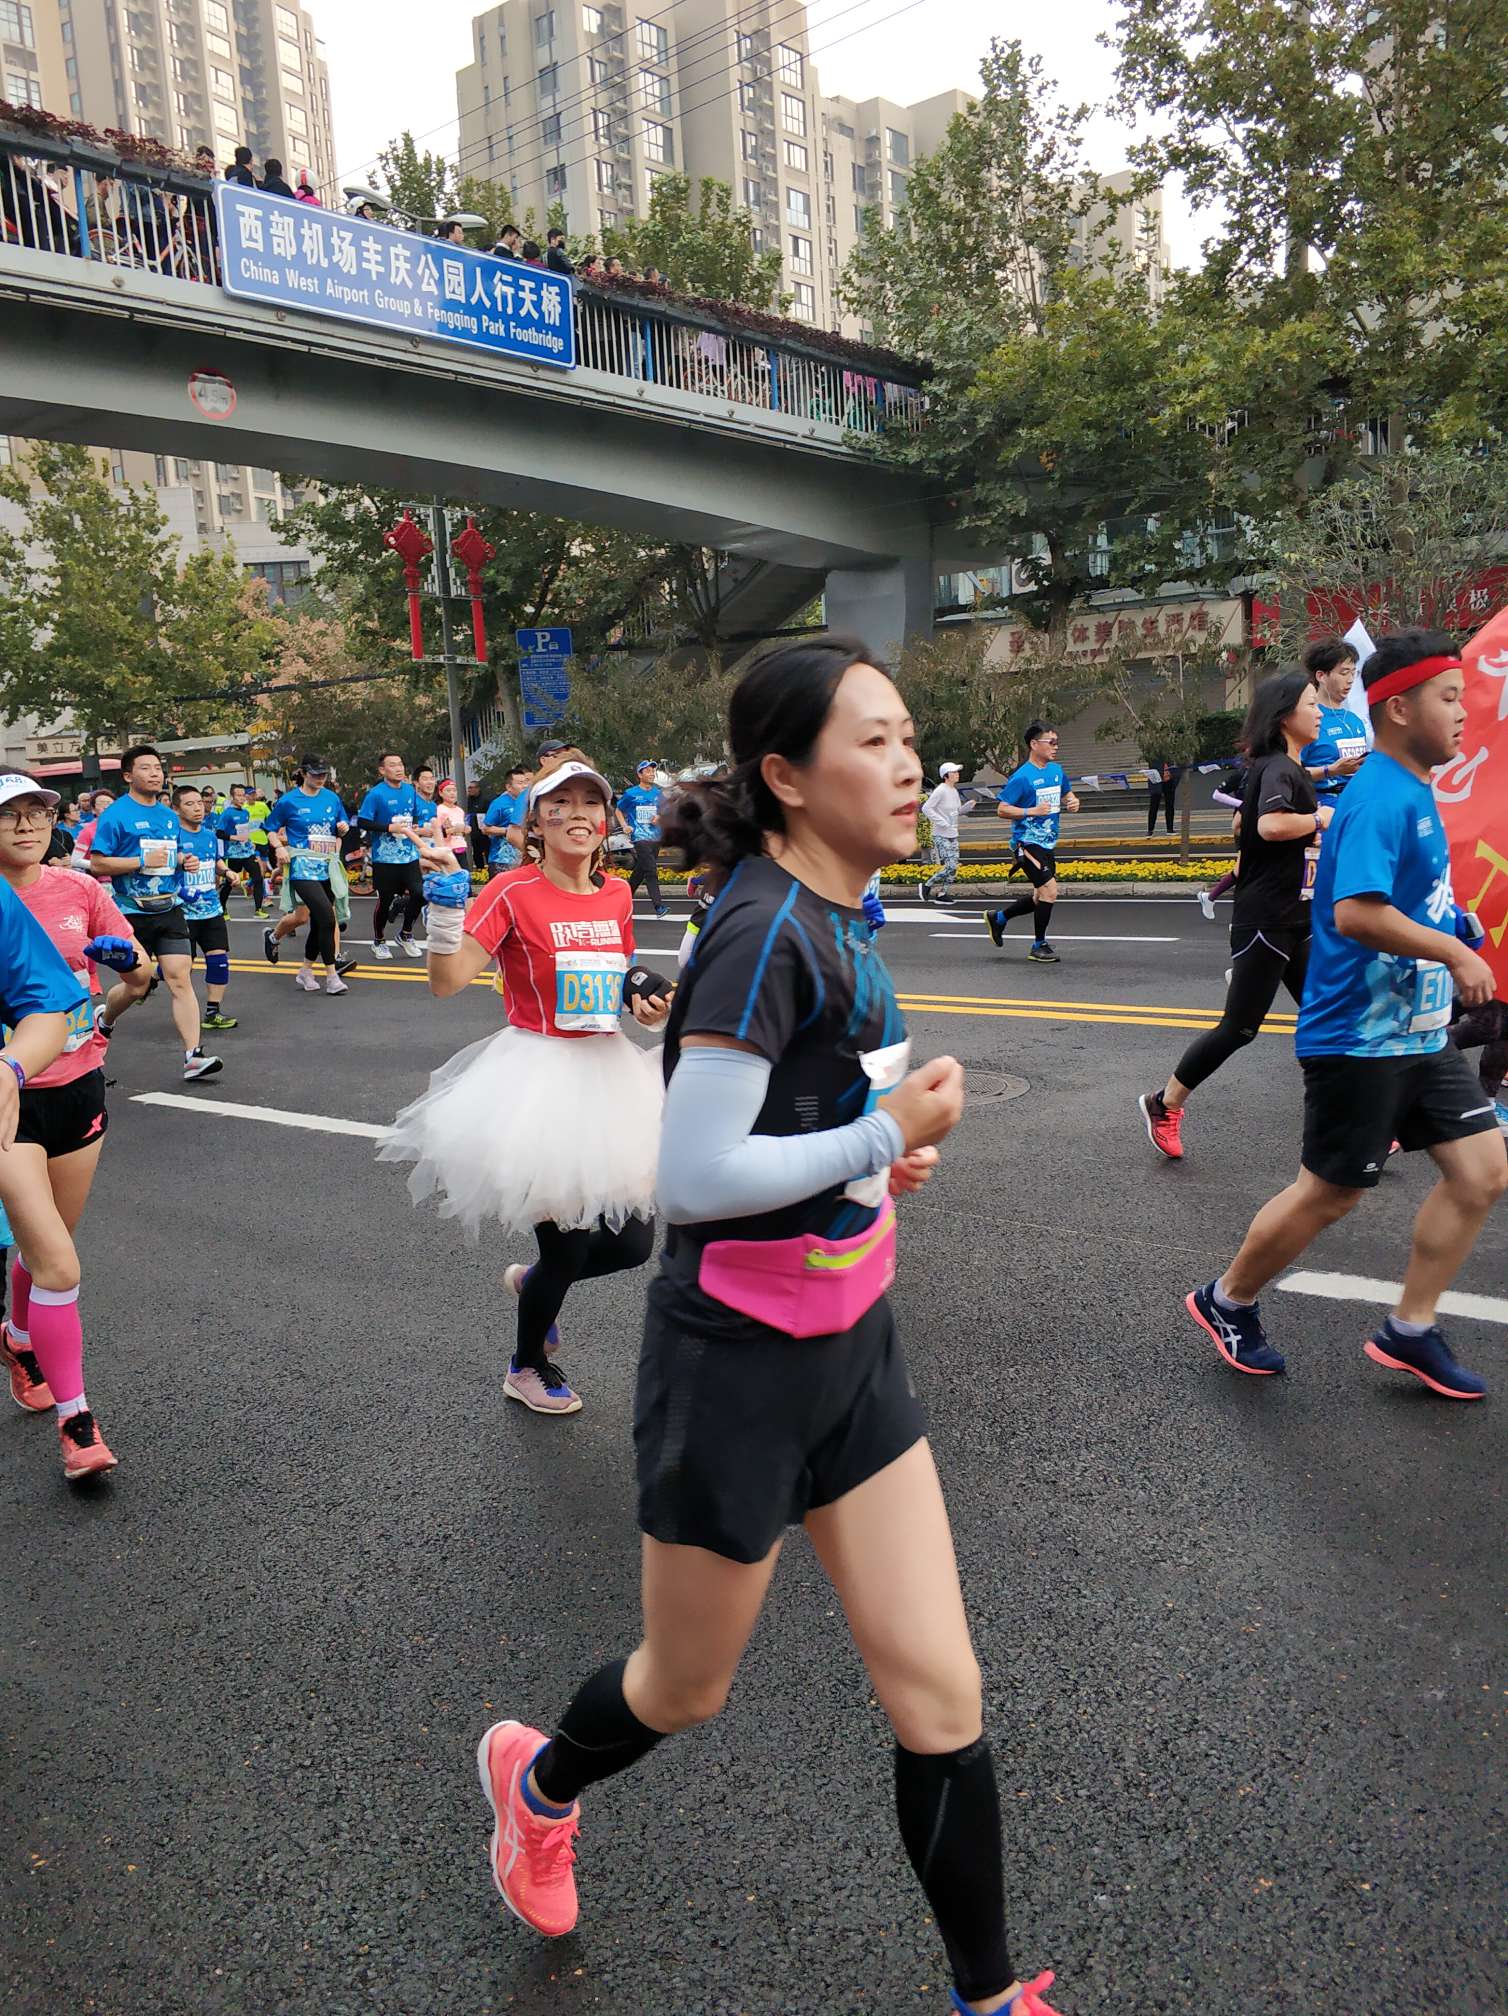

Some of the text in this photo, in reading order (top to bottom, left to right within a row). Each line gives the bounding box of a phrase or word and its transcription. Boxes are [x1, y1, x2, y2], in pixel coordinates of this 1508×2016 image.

[235, 203, 561, 327] 西部机场丰庆公园人行天桥
[240, 257, 565, 353] China West Airport Group & Fengqing Park Footbridge
[535, 632, 551, 653] P
